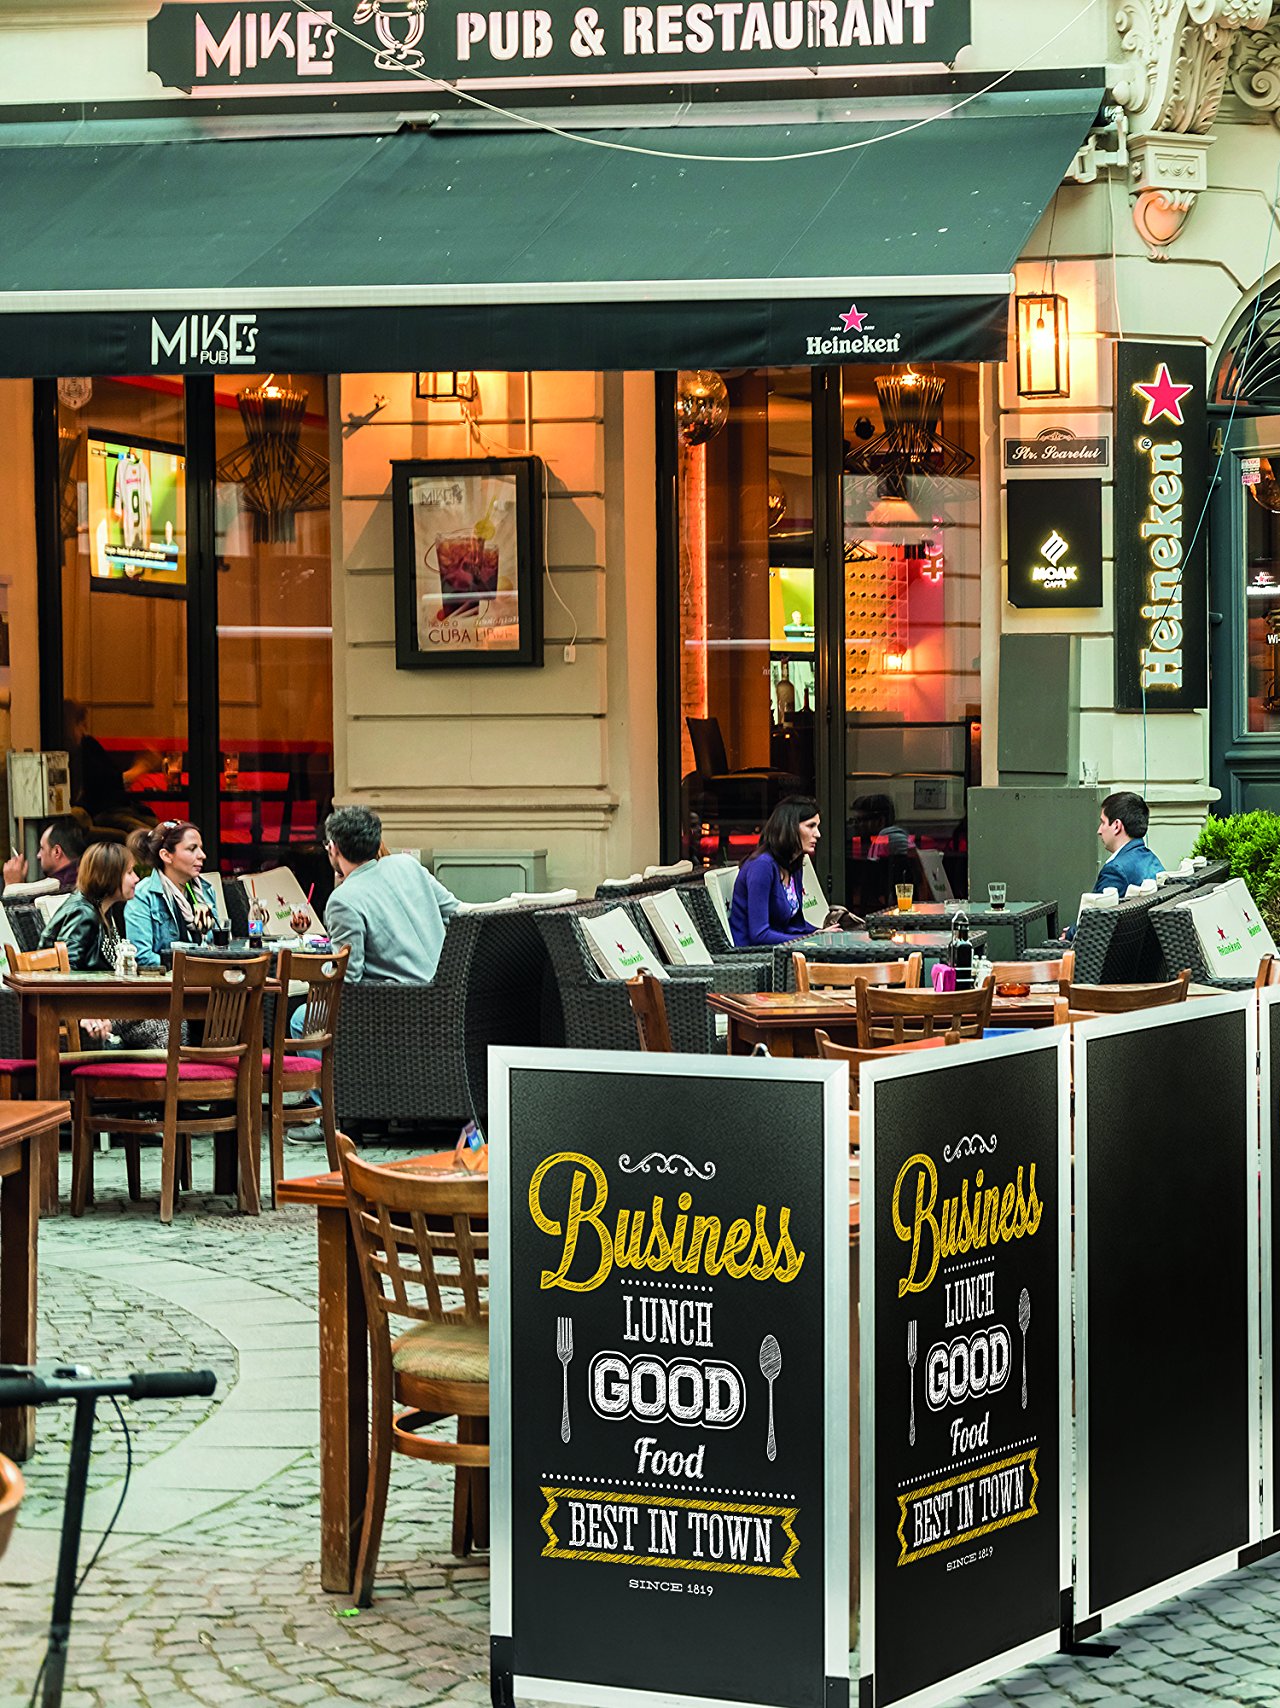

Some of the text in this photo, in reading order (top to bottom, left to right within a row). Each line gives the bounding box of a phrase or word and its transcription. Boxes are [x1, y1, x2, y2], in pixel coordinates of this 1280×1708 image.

[456, 9, 553, 61] PUB
[569, 5, 607, 57] &
[623, 0, 934, 55] RESTAURANT
[200, 350, 229, 365] PUB
[806, 334, 901, 355] Heineken
[1012, 445, 1101, 460] Str. Soarelui
[1212, 428, 1223, 455] 4
[1141, 438, 1183, 688] Heineken
[428, 628, 472, 644] CUBA
[528, 1152, 806, 1292] Business
[892, 1153, 1043, 1298] Business
[623, 1295, 714, 1347] LUNCH
[944, 1271, 995, 1328] LUNCH
[592, 1353, 744, 1426] GOOD
[927, 1328, 1010, 1408] GOOD
[634, 1427, 706, 1479] Food
[950, 1411, 990, 1456] Food
[568, 1502, 773, 1563] BEST IN TOWN
[913, 1465, 1026, 1548] BEST IN TOWN
[628, 1578, 714, 1597] SINCE 1819
[946, 1552, 977, 1572] SINCE
